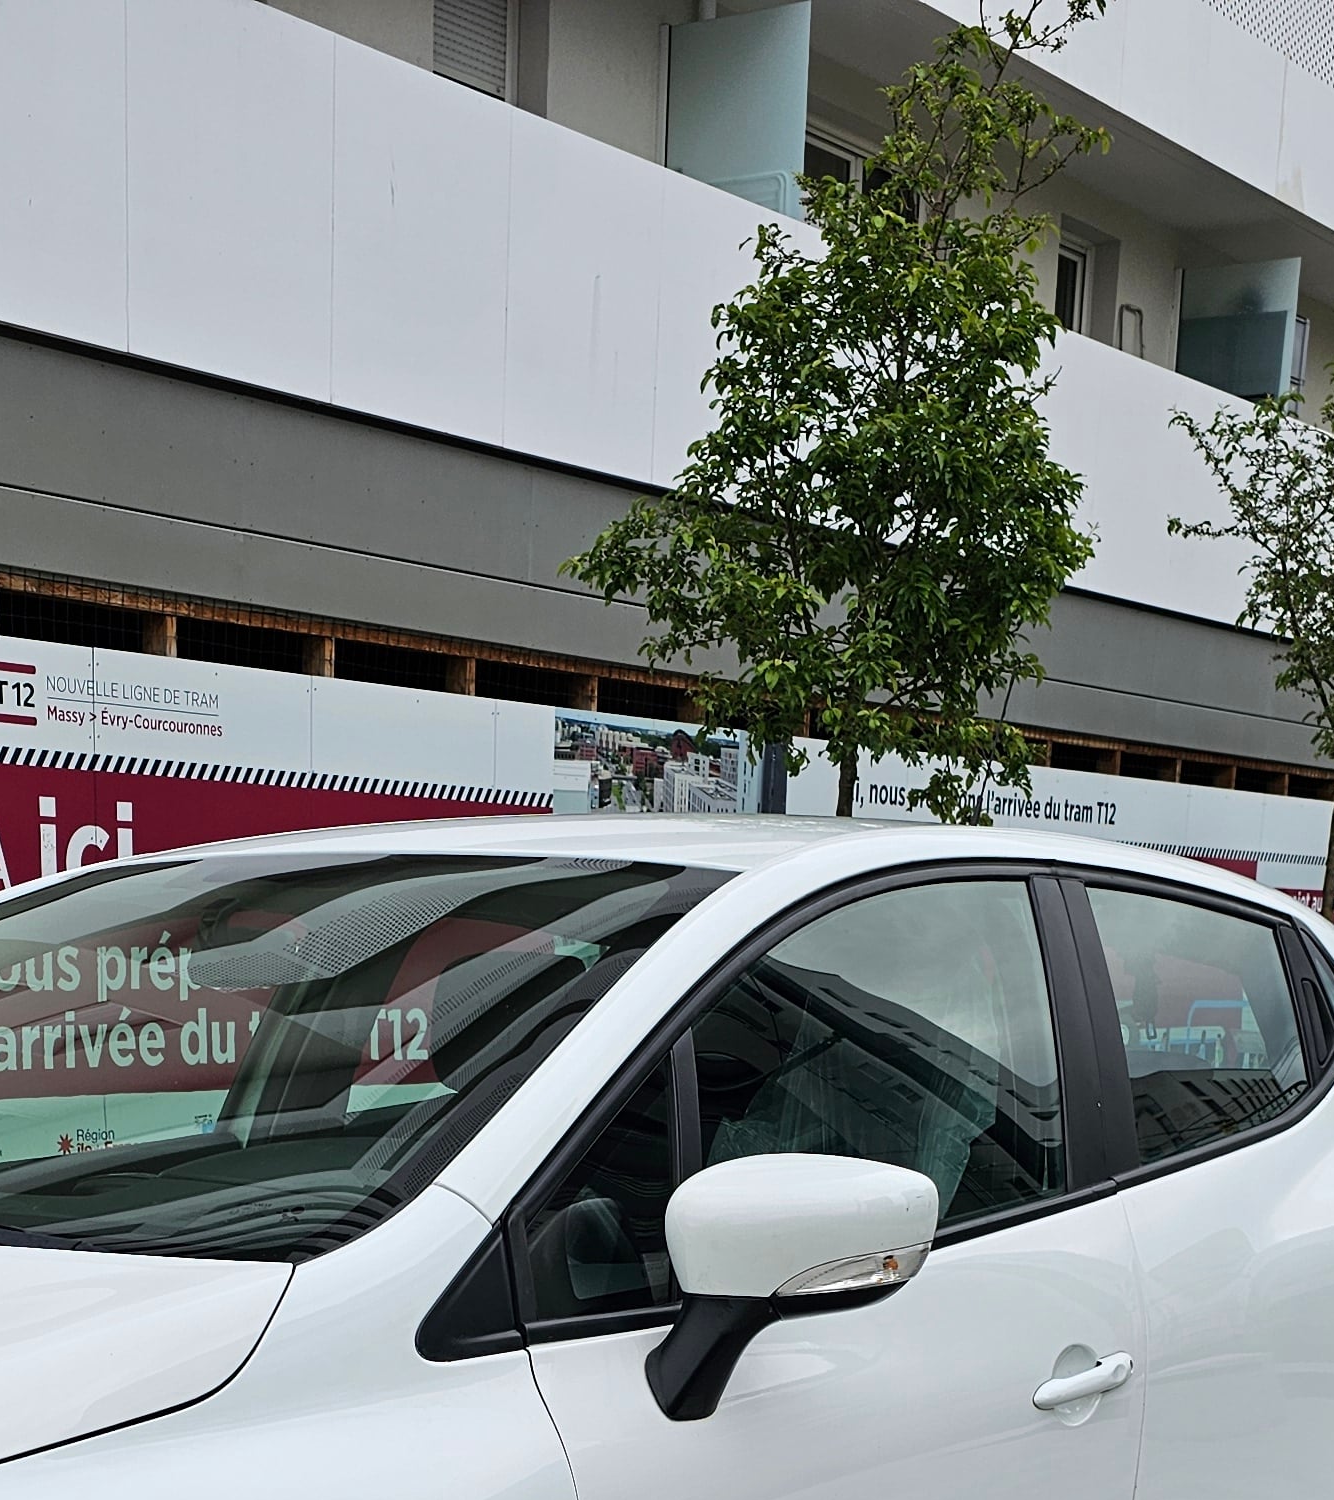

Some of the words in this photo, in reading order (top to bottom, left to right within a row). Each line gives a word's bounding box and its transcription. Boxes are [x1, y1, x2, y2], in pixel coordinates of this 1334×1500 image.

[46, 675, 119, 699] NOUVELLE
[122, 684, 160, 703] LIGNE
[164, 688, 181, 706] DE
[184, 691, 219, 710] TRAM
[47, 705, 86, 727] Massy
[101, 707, 223, 737] Évry-Courcouronnes
[869, 783, 906, 807] nous
[1044, 795, 1061, 820] du
[1064, 799, 1093, 823] tram
[1096, 801, 1117, 826] T12
[39, 795, 133, 878] ici
[180, 1008, 236, 1066] du
[76, 1128, 115, 1144] Région
